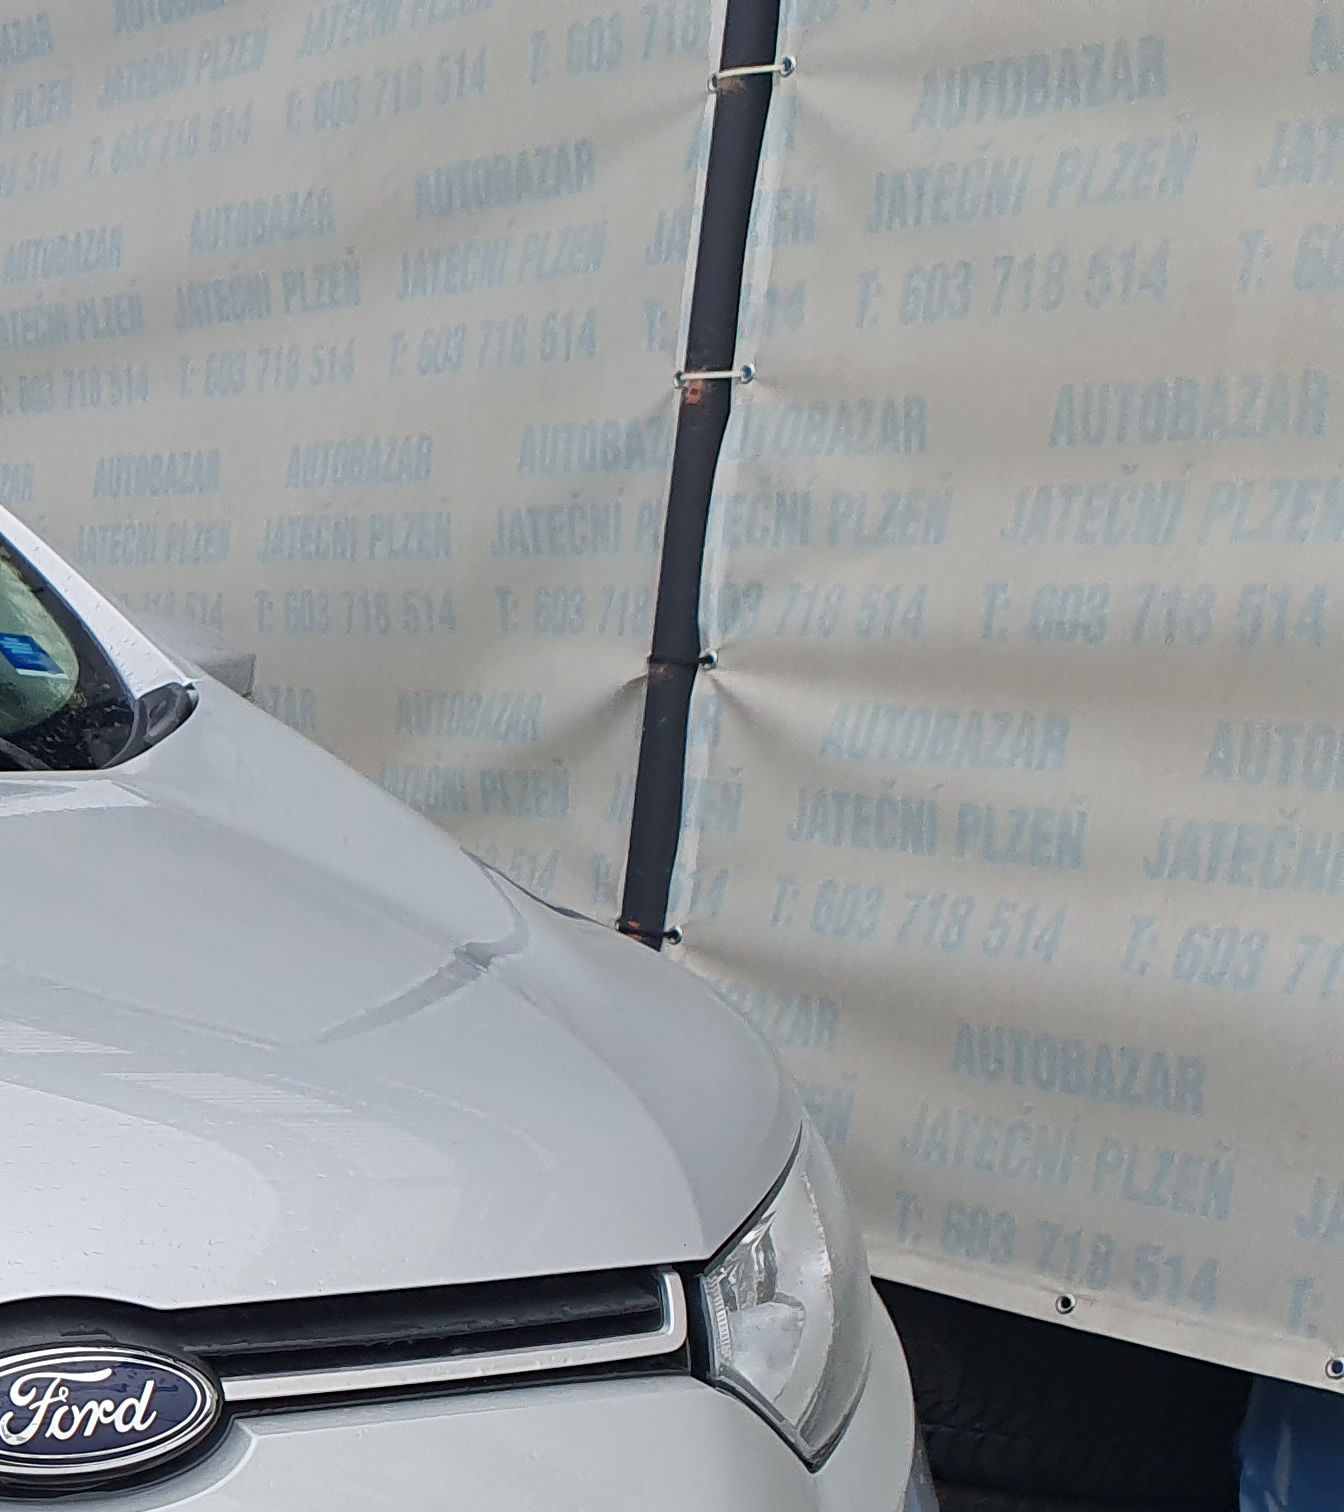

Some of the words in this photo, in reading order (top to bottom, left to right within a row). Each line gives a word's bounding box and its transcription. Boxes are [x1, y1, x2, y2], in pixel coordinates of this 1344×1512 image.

[912, 33, 1167, 132] AUTOBAZAR
[1048, 370, 1329, 447] AUTOBAZAR
[951, 1018, 1207, 1119] AUTOBAZAR
